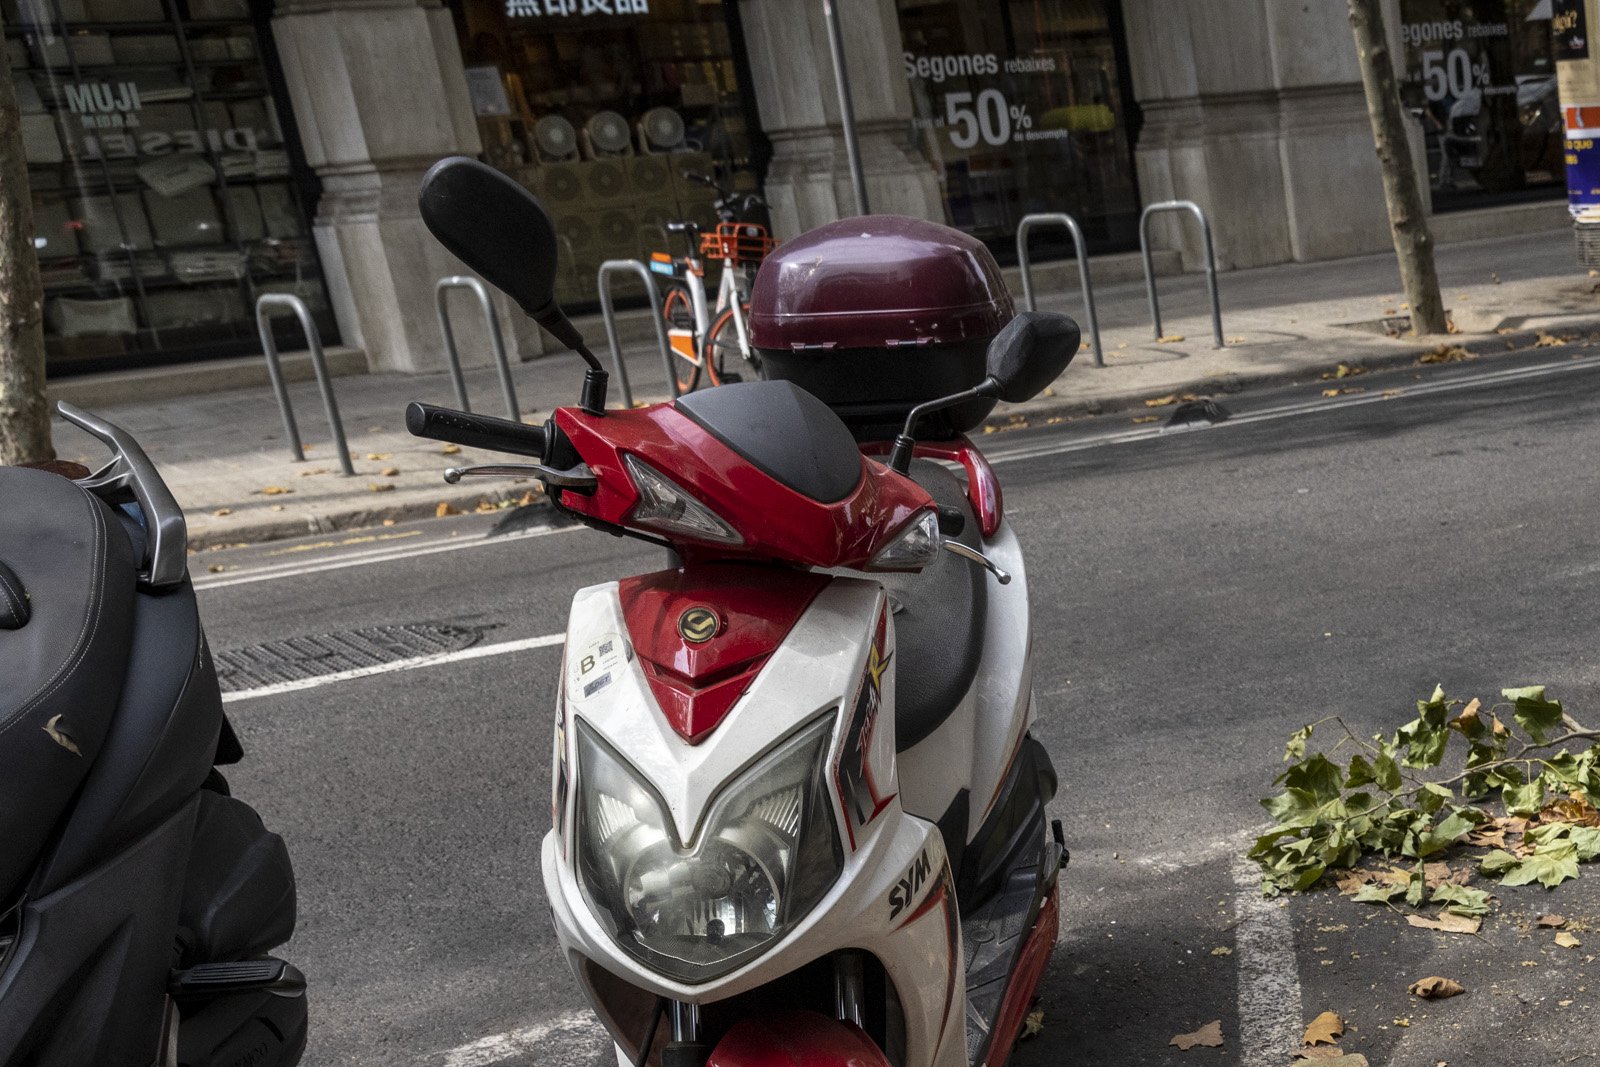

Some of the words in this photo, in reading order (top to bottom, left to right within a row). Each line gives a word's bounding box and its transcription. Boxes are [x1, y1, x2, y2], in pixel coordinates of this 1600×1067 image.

[1400, 20, 1464, 47] egones
[902, 52, 999, 83] Segones
[1003, 56, 1056, 74] rebaixes
[64, 82, 142, 113] MUJI
[580, 654, 596, 675] B
[889, 848, 932, 921] SYM
